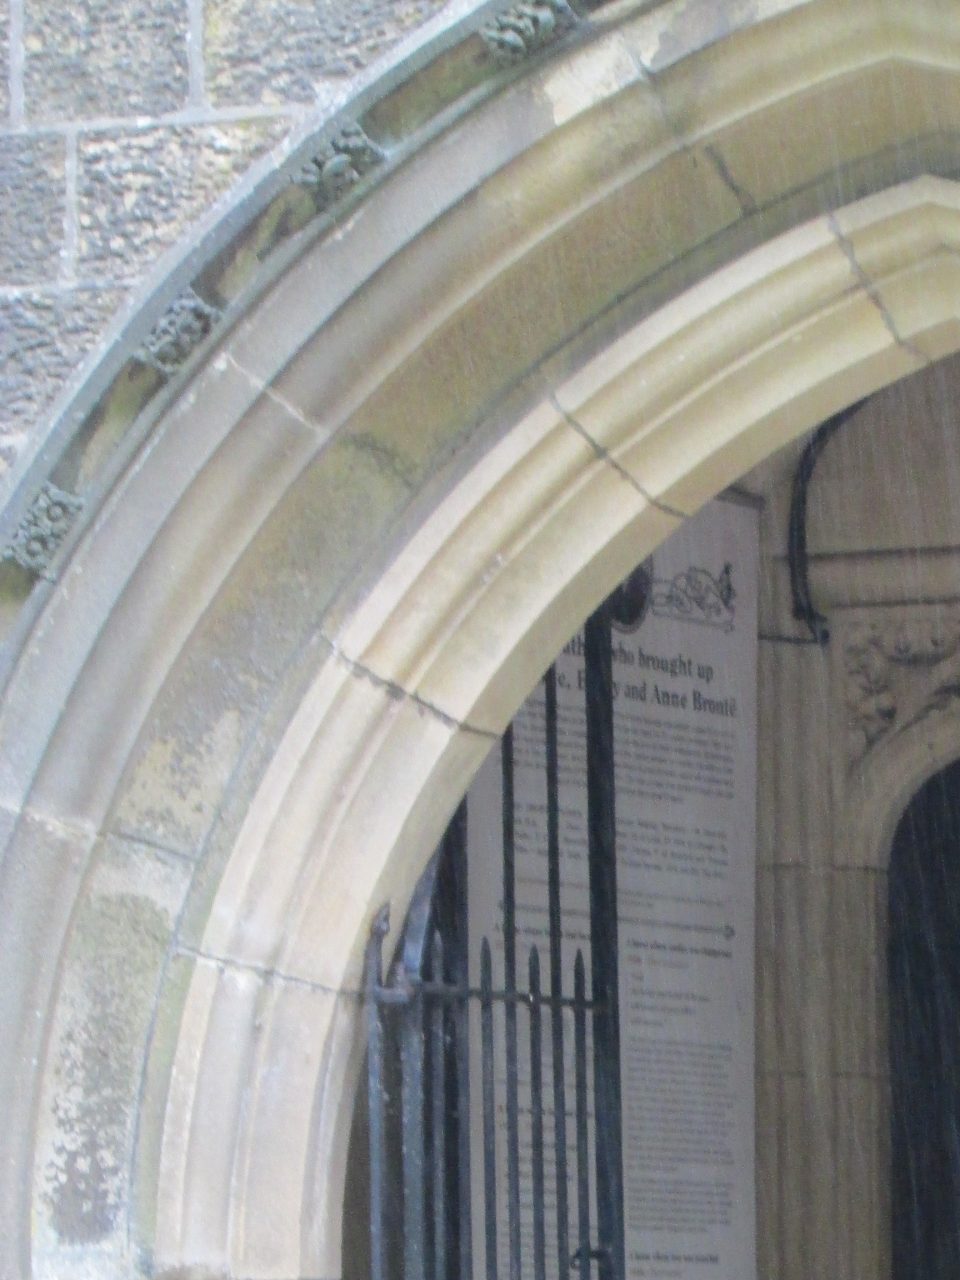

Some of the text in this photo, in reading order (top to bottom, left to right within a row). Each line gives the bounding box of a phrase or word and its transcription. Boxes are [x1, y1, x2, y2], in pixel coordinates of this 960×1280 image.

[638, 646, 692, 678] brought
[697, 664, 714, 684] up
[624, 681, 647, 701] and
[654, 685, 688, 709] Anne
